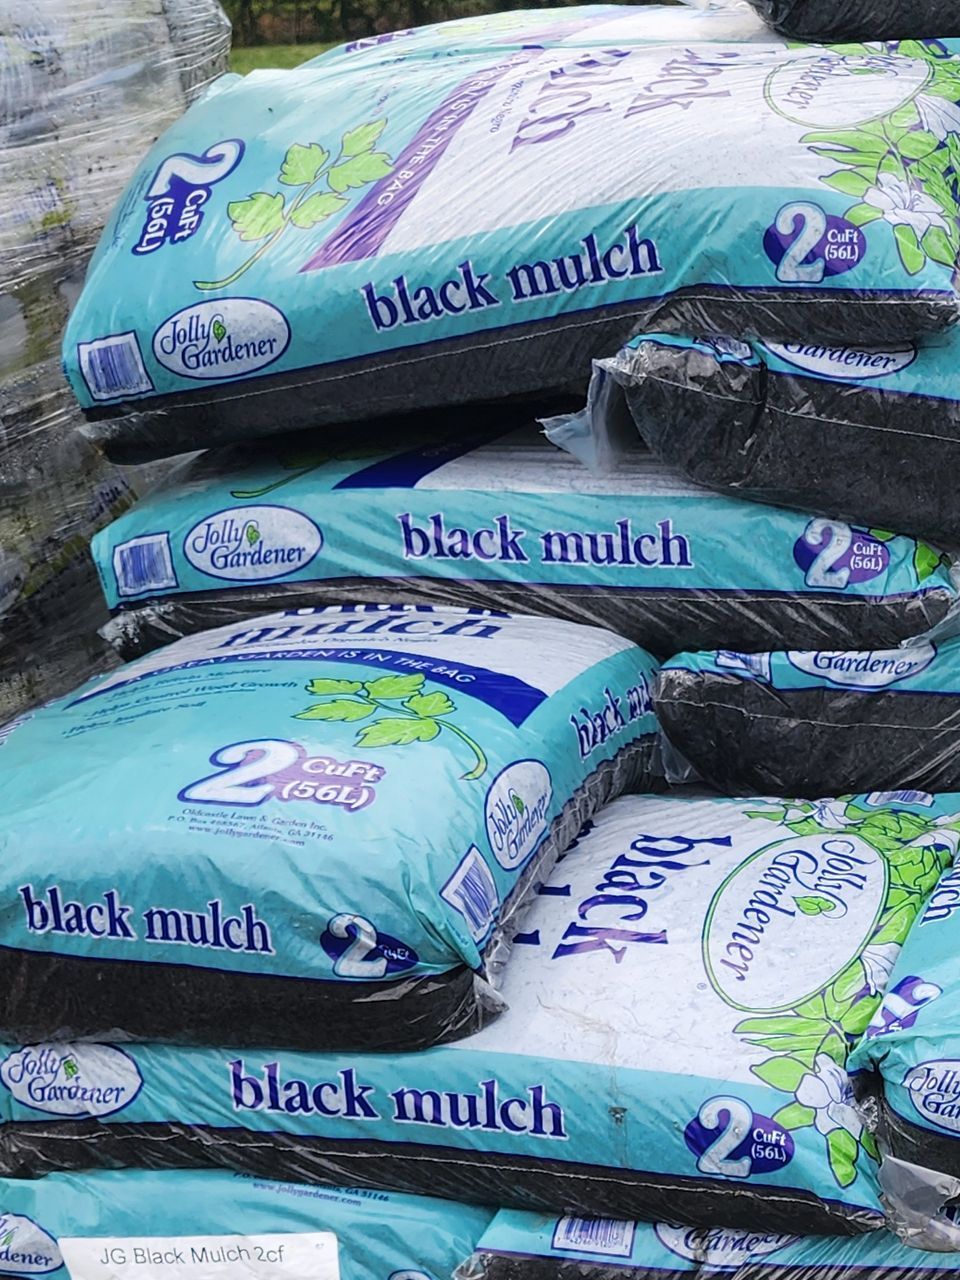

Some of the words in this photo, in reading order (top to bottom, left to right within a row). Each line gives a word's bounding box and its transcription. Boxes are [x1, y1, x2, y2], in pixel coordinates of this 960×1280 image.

[150, 138, 245, 200] 2
[377, 169, 414, 207] BAG
[135, 197, 175, 254] (56L)
[174, 188, 207, 242] CuFt
[775, 201, 827, 284] 2
[824, 245, 860, 262] (56L)
[826, 228, 859, 243] CuFt
[361, 260, 501, 332] black
[505, 225, 664, 301] mulch
[160, 314, 214, 354] Jolly
[181, 334, 278, 370] Gardener
[191, 520, 244, 555] Jolly
[210, 539, 306, 570] Gardener
[398, 513, 530, 564] black
[540, 518, 693, 568] mulch
[804, 518, 855, 590] 2
[852, 542, 883, 555] CuFt
[850, 555, 884, 572] (56L)
[214, 614, 504, 649] mulch
[239, 648, 336, 661] GARDEN
[337, 649, 358, 658] IS
[362, 651, 389, 663] IN
[393, 656, 430, 671] THE
[430, 665, 479, 684] BAG
[813, 650, 919, 677] Gardener
[569, 687, 627, 759] black
[179, 739, 299, 807] 2
[301, 757, 382, 782] CuFt
[281, 780, 371, 810] (56L)
[488, 797, 520, 851] Jolly
[820, 839, 870, 898] Jolly
[552, 833, 734, 964] black
[719, 850, 820, 982] Gardener
[19, 884, 138, 942] black
[144, 901, 275, 955] mulch
[328, 912, 389, 979] 2
[7, 1047, 64, 1083] Jolly
[27, 1076, 126, 1105] Gardener
[227, 1059, 382, 1119] black
[390, 1079, 570, 1140] mulch
[696, 1095, 753, 1179] 2
[751, 1146, 788, 1163] (56L)
[752, 1127, 787, 1147] CuFt
[0, 1245, 54, 1267] dener
[99, 1246, 127, 1265] JG
[133, 1246, 187, 1265] Black
[190, 1245, 252, 1264] Mulch
[253, 1244, 286, 1263] 2cf
